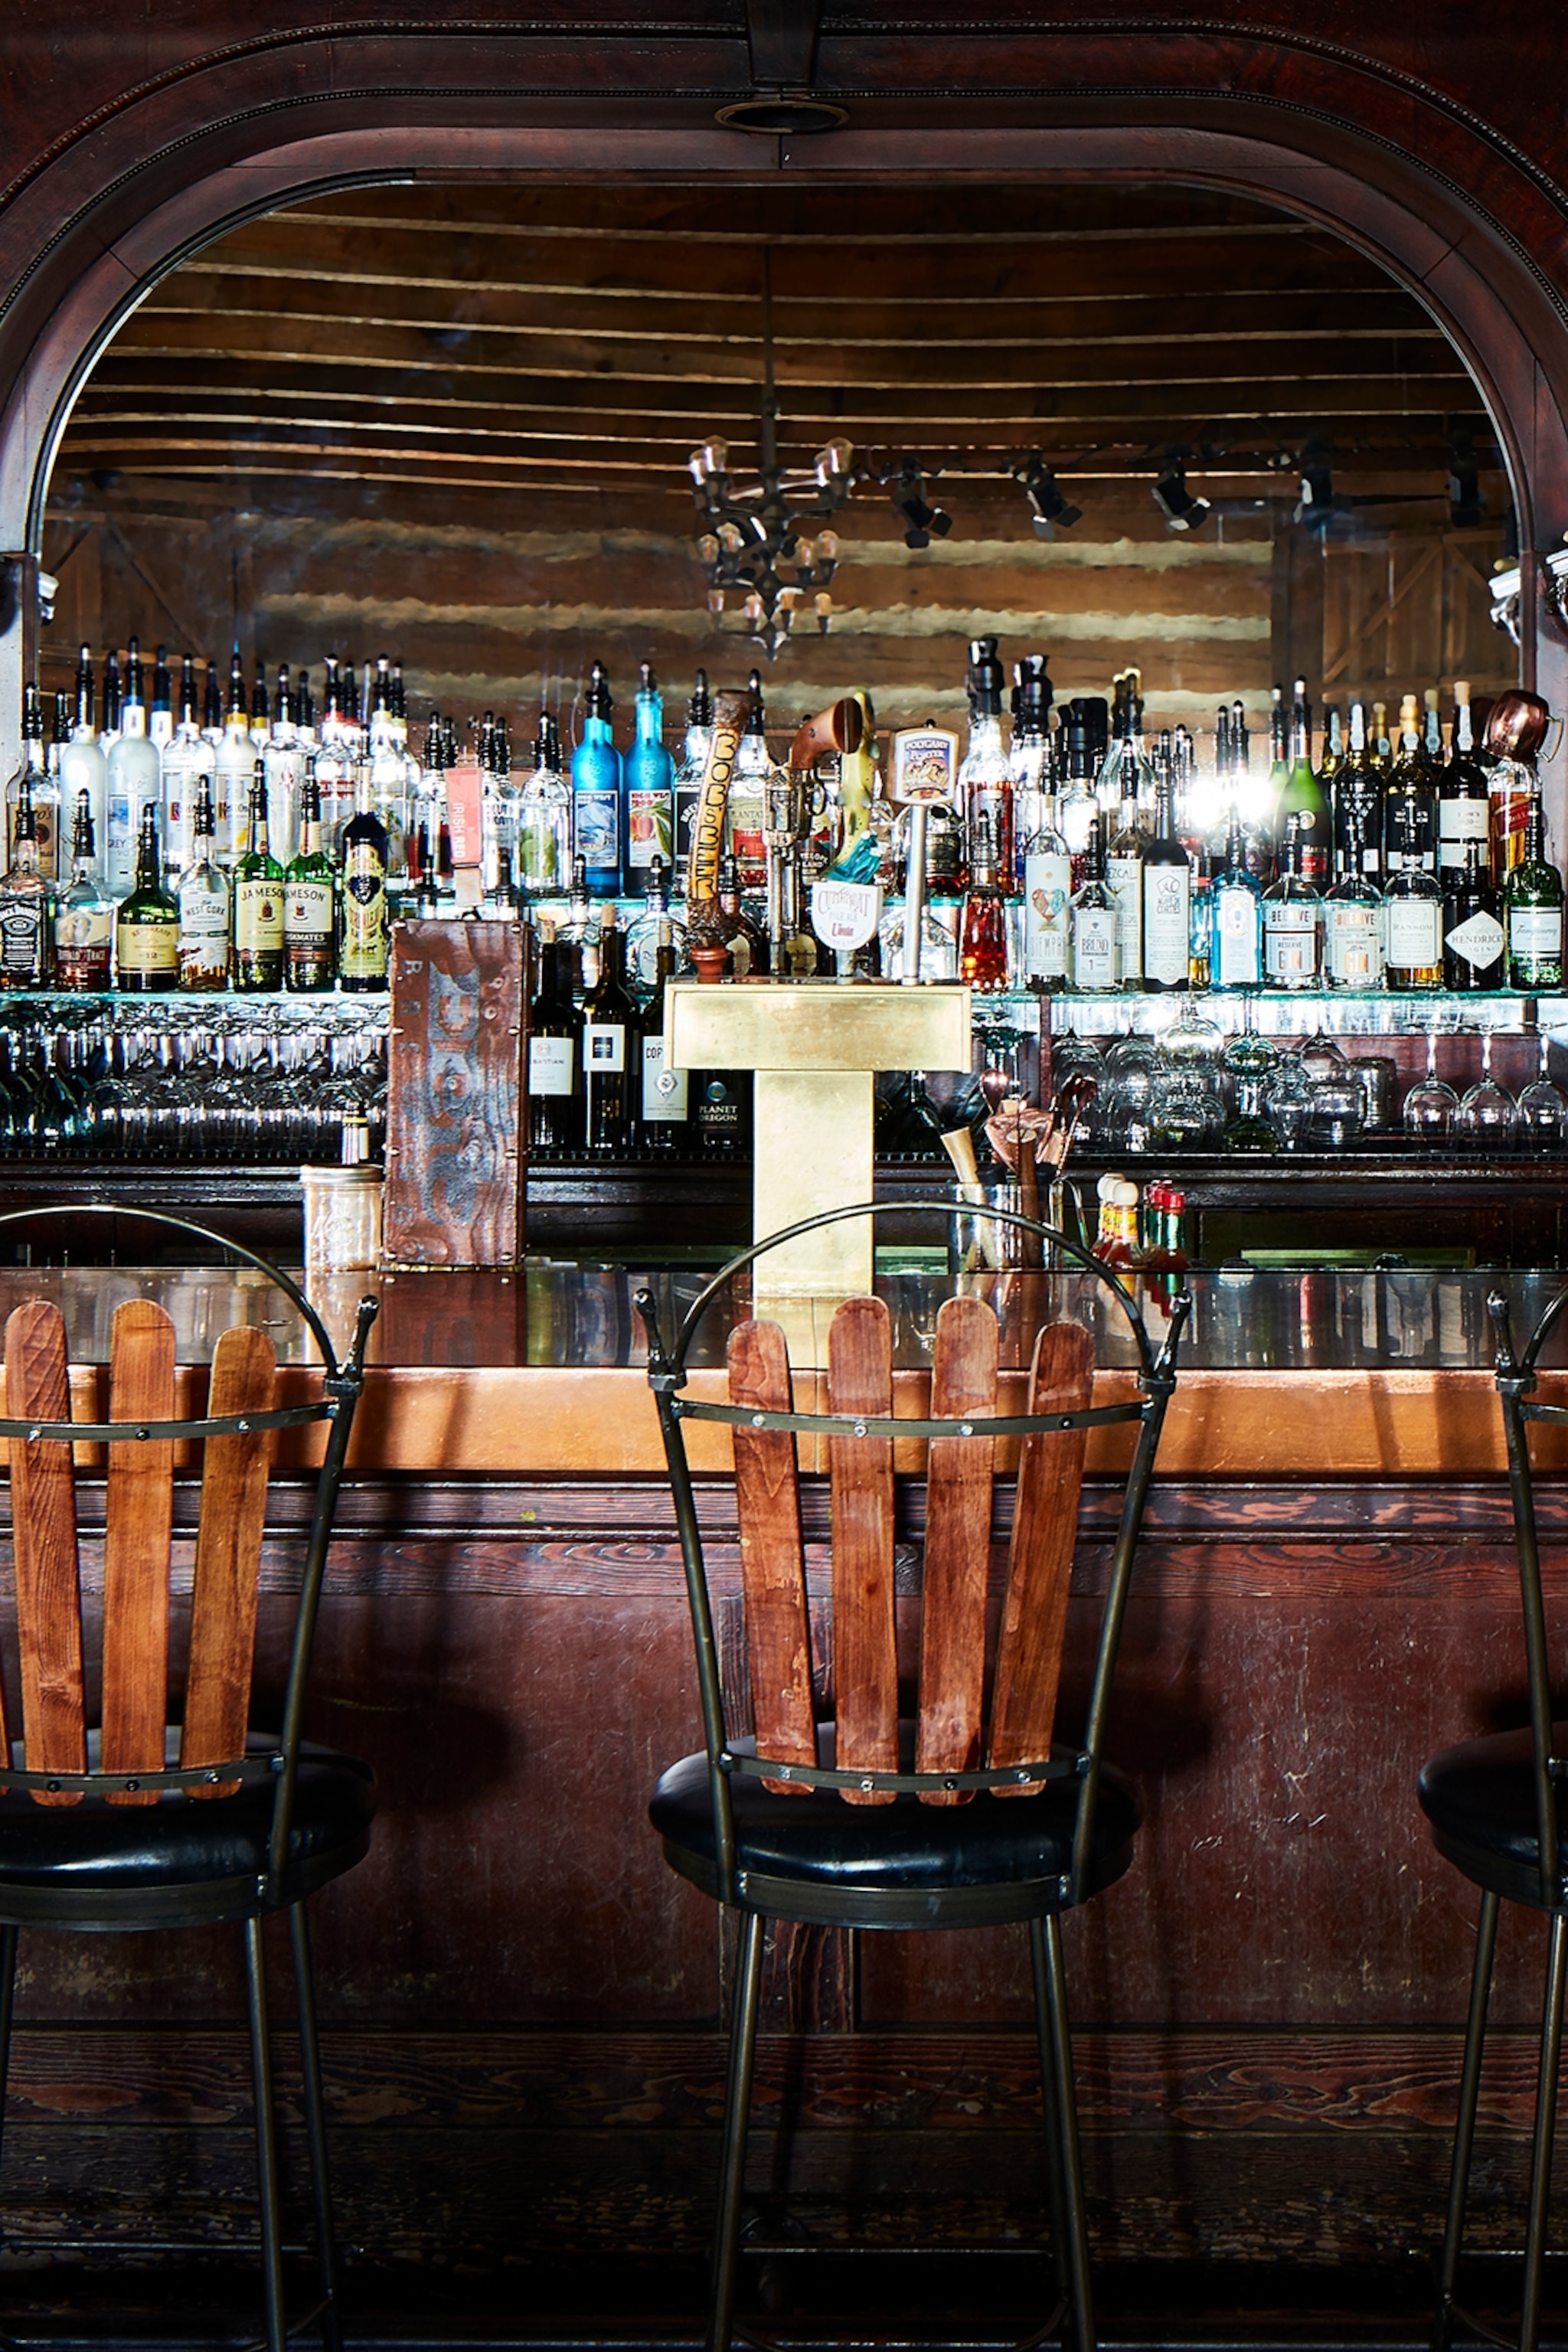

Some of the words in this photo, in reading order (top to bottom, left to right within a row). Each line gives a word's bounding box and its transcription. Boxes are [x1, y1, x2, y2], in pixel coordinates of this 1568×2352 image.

[703, 733, 737, 825] BOB'S
[452, 802, 466, 833] IRISH
[452, 835, 466, 859] RED
[695, 825, 720, 901] BEER
[1107, 866, 1138, 880] EZCAL
[241, 887, 283, 901] JAMESO
[285, 888, 326, 902] AMESON
[185, 906, 204, 916] WEST
[205, 905, 226, 916] CORK
[698, 1105, 738, 1114] PLANET
[698, 1113, 738, 1122] OREGON
